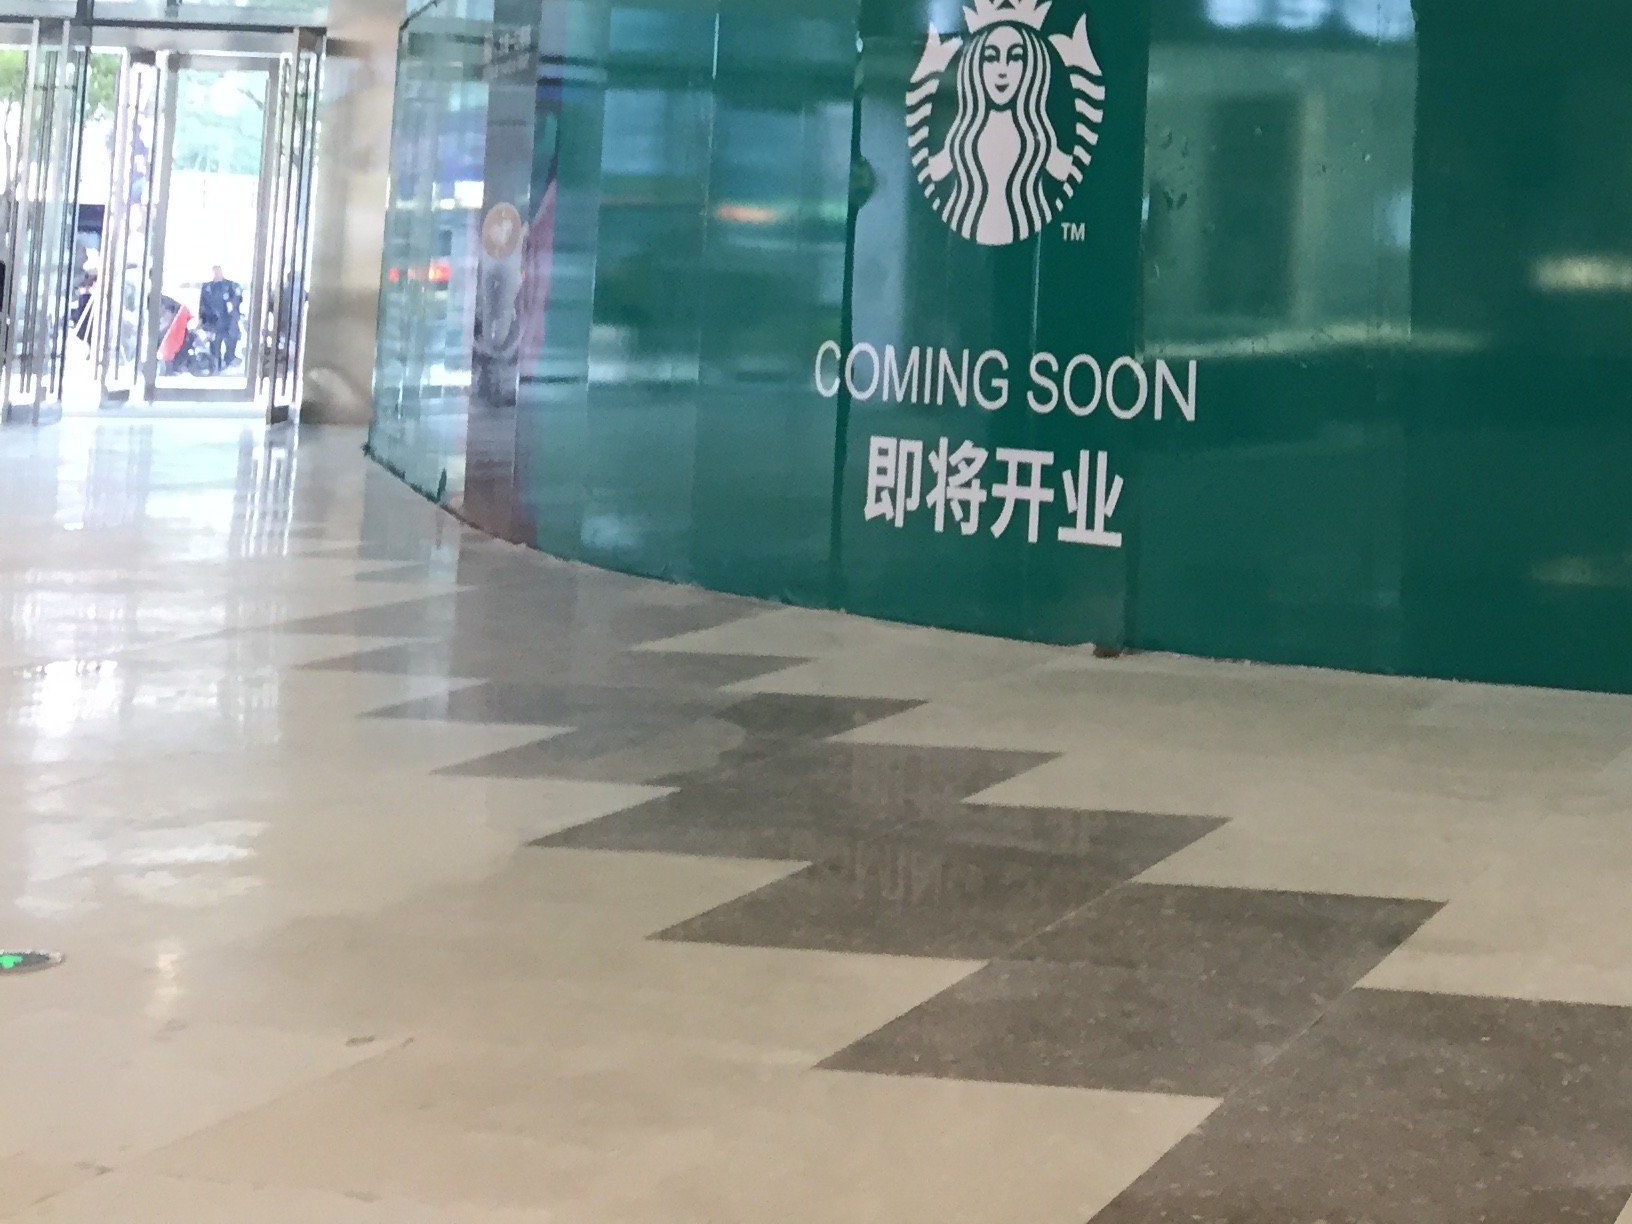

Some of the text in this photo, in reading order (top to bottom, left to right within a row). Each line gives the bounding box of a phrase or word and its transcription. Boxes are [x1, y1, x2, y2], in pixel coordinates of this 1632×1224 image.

[1061, 222, 1087, 242] TM
[814, 339, 1198, 422] COMING SOON
[863, 434, 1125, 548] 即将开业
